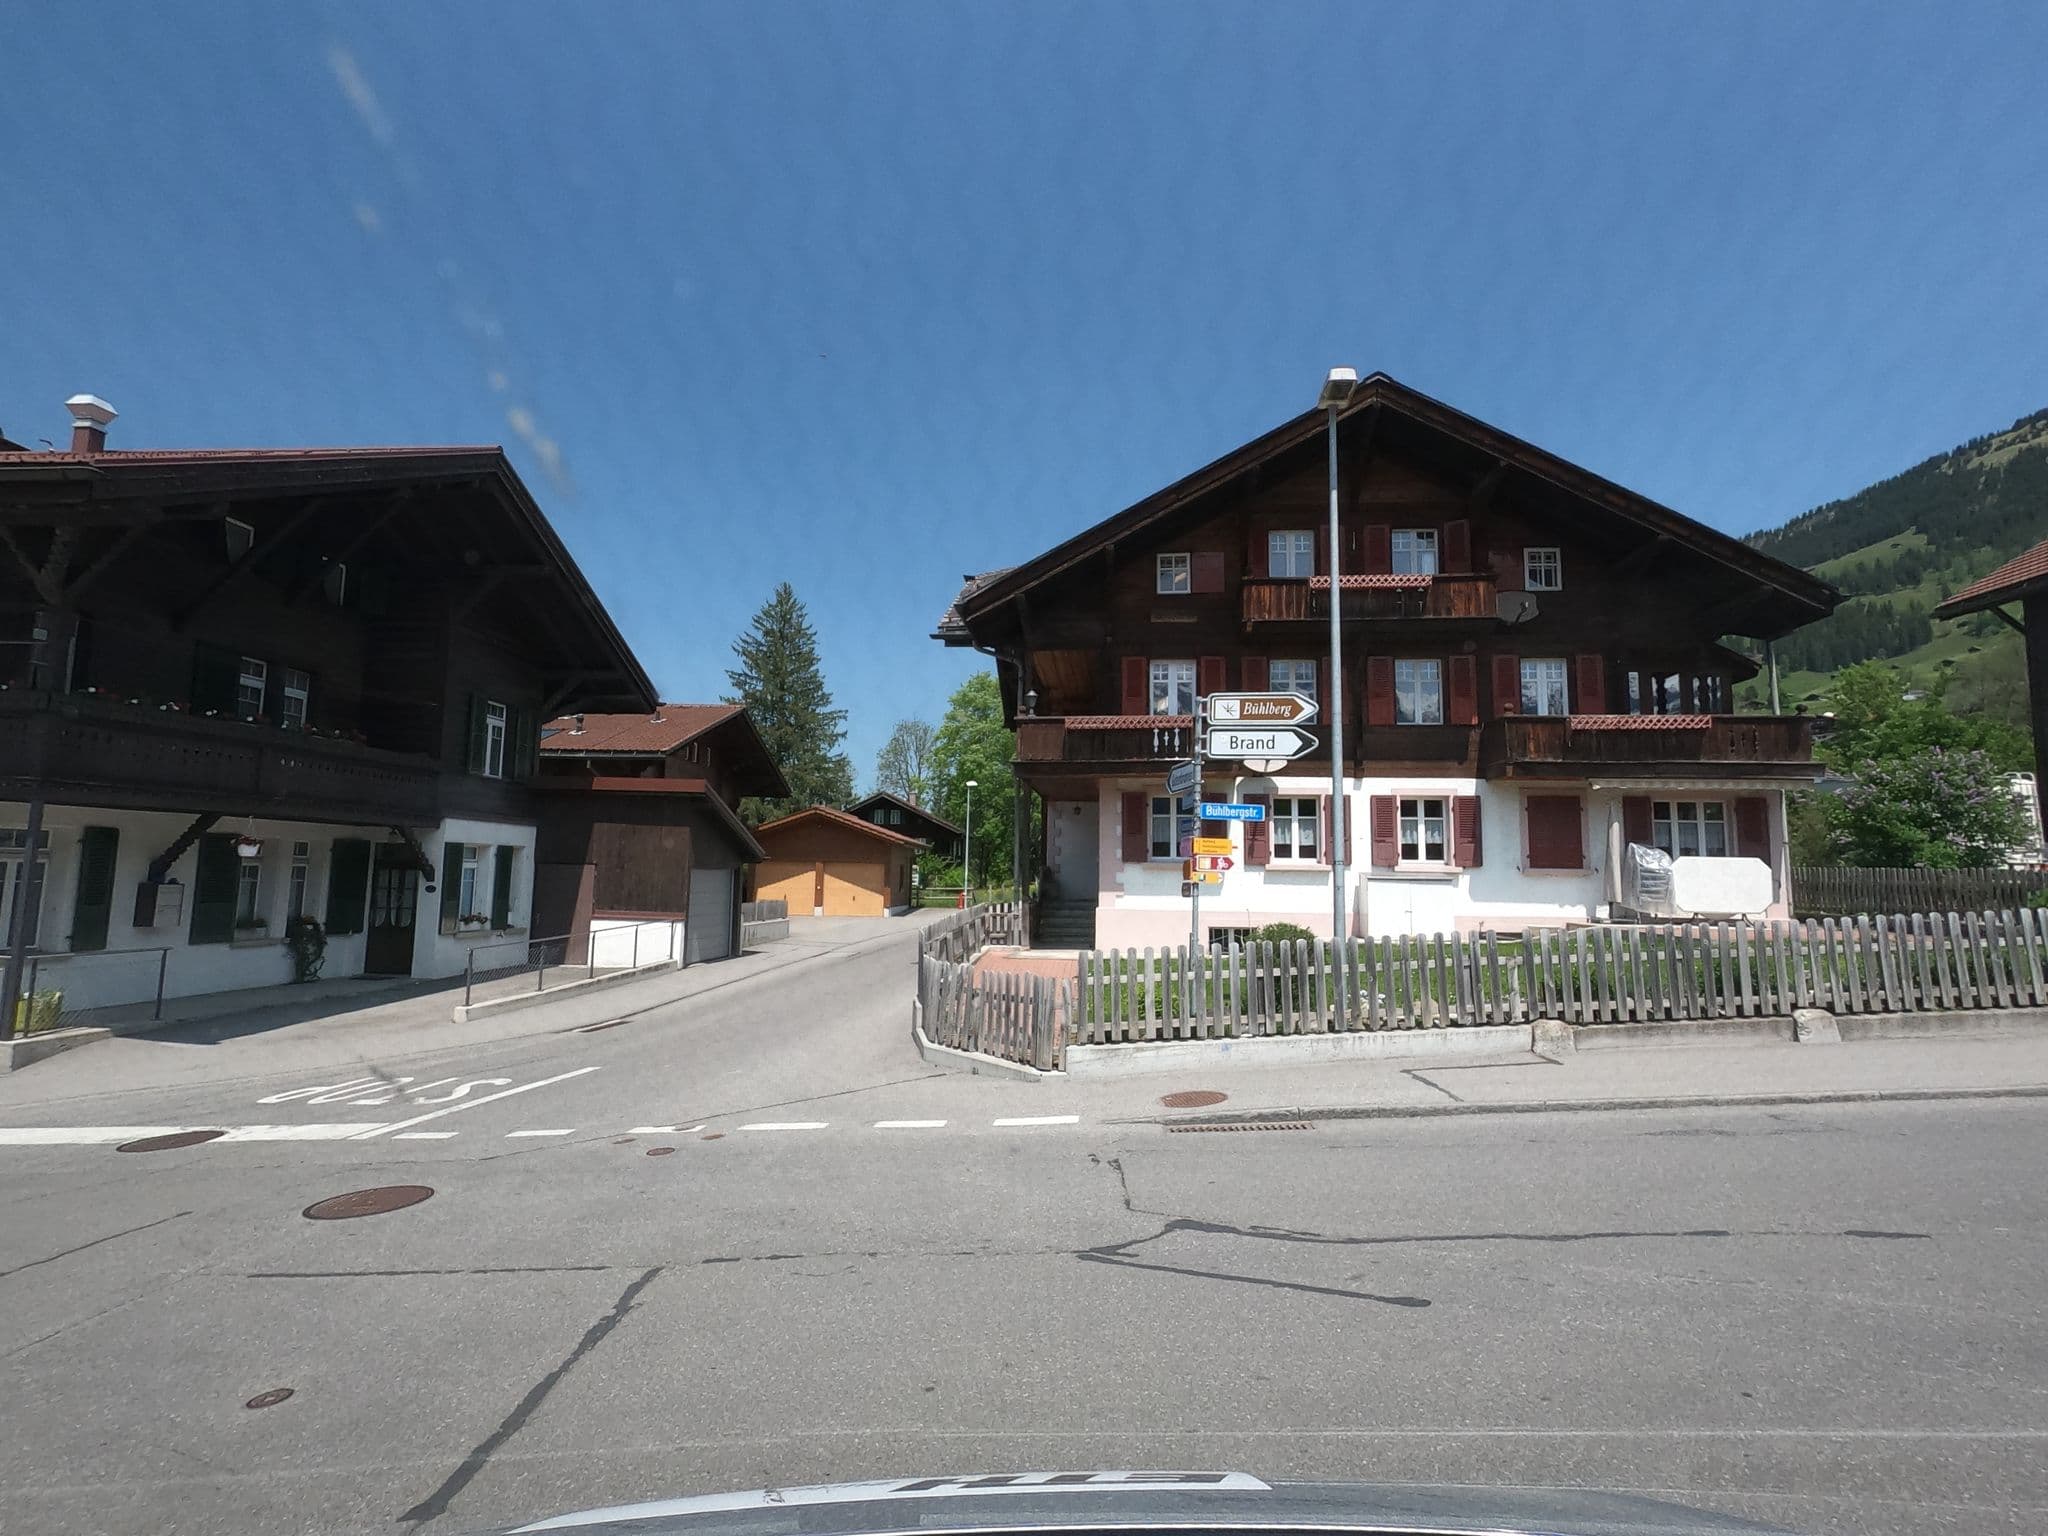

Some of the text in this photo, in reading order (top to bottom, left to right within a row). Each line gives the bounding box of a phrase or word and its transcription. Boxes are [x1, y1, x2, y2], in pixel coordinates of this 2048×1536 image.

[1243, 702, 1292, 717] Bühlberg
[1230, 734, 1275, 750] Brand
[1206, 804, 1259, 820] Bühlbergstr.
